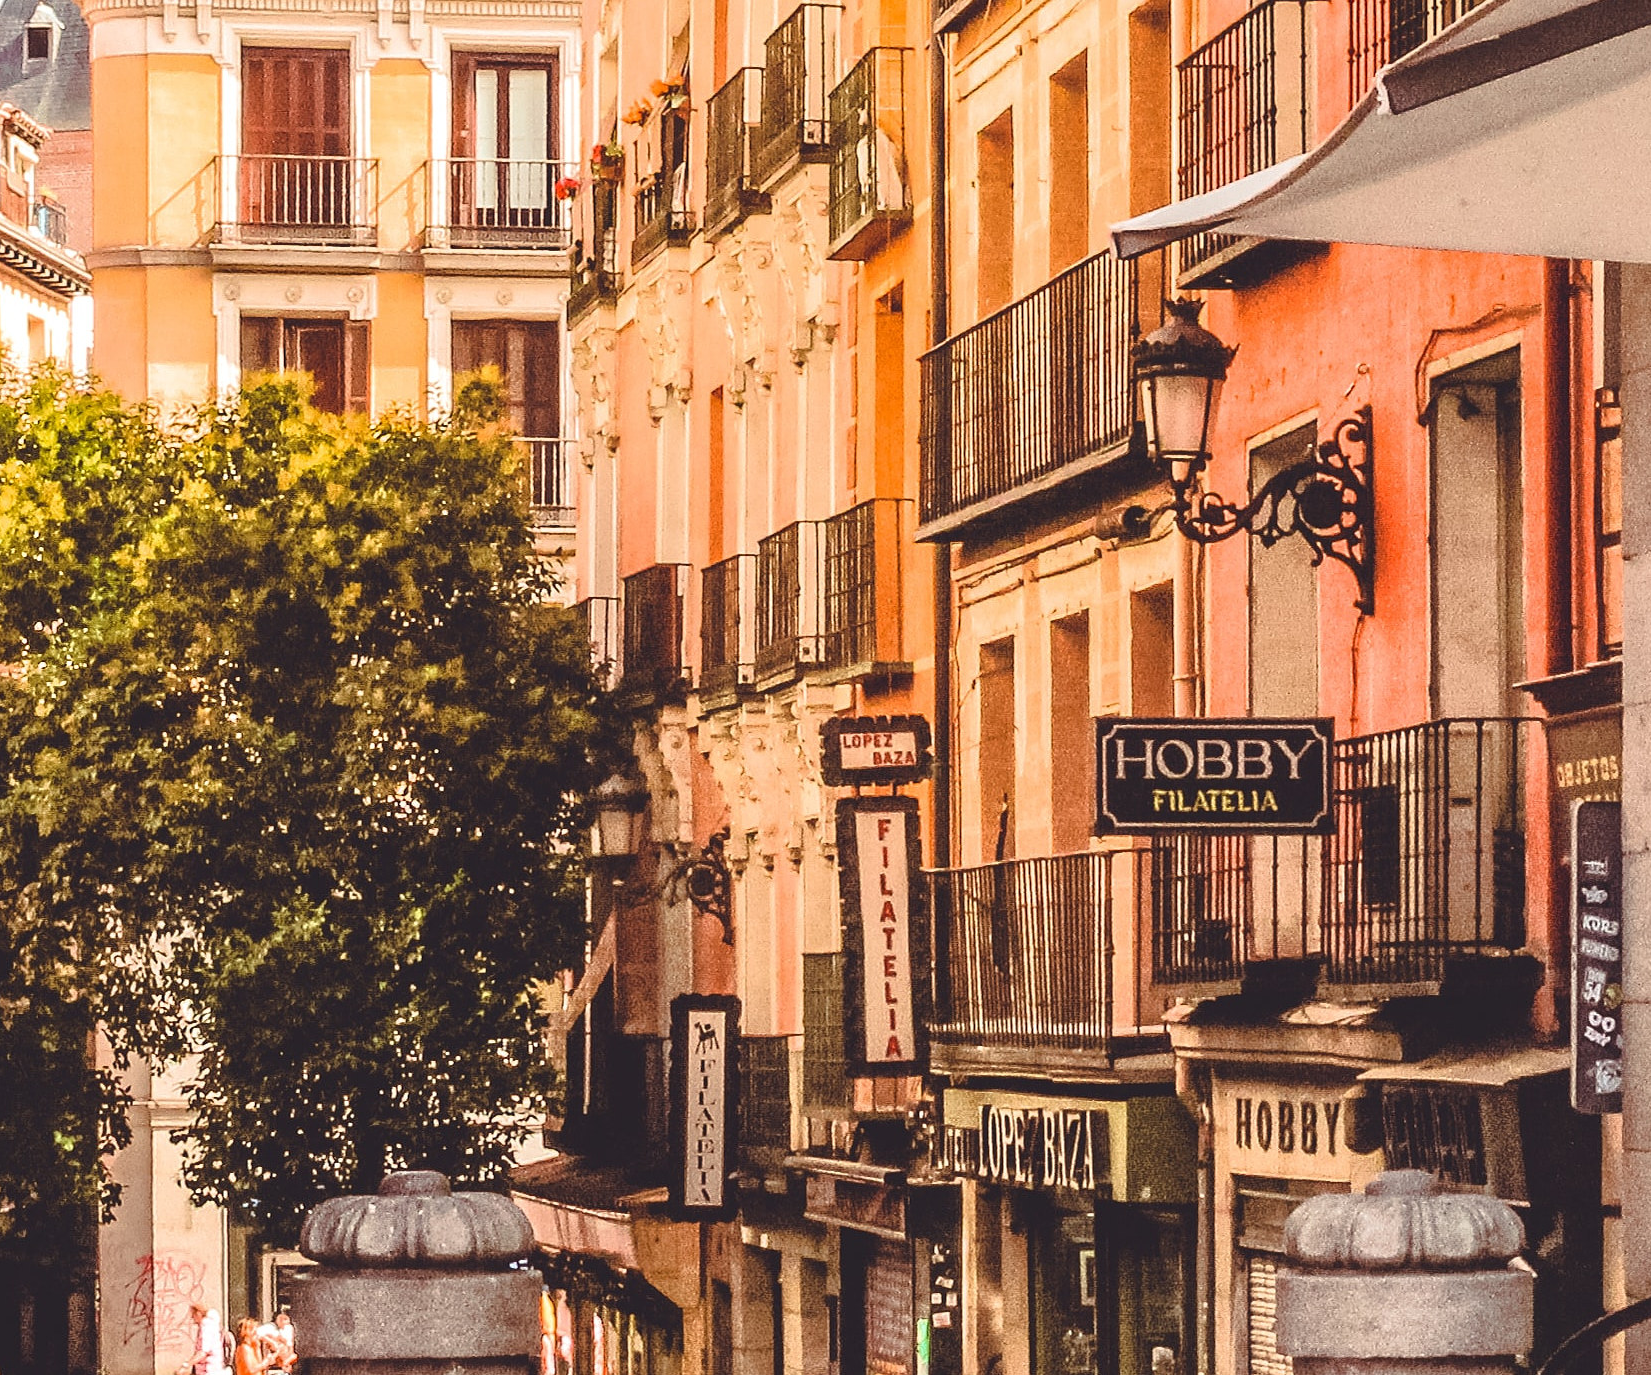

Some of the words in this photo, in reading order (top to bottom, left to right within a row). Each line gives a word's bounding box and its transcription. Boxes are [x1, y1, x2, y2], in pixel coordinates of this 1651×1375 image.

[843, 734, 893, 749] LOPEZ
[873, 751, 915, 765] BAZA
[1115, 739, 1316, 780] HOBBY
[1152, 789, 1279, 812] FILATELIA
[877, 818, 901, 1058] FILATELIA
[694, 1059, 717, 1203] FILATELIA
[978, 1104, 1040, 1189] LOPEZ
[1043, 1108, 1095, 1190] BAZA
[1236, 1097, 1340, 1156] HOBBY
